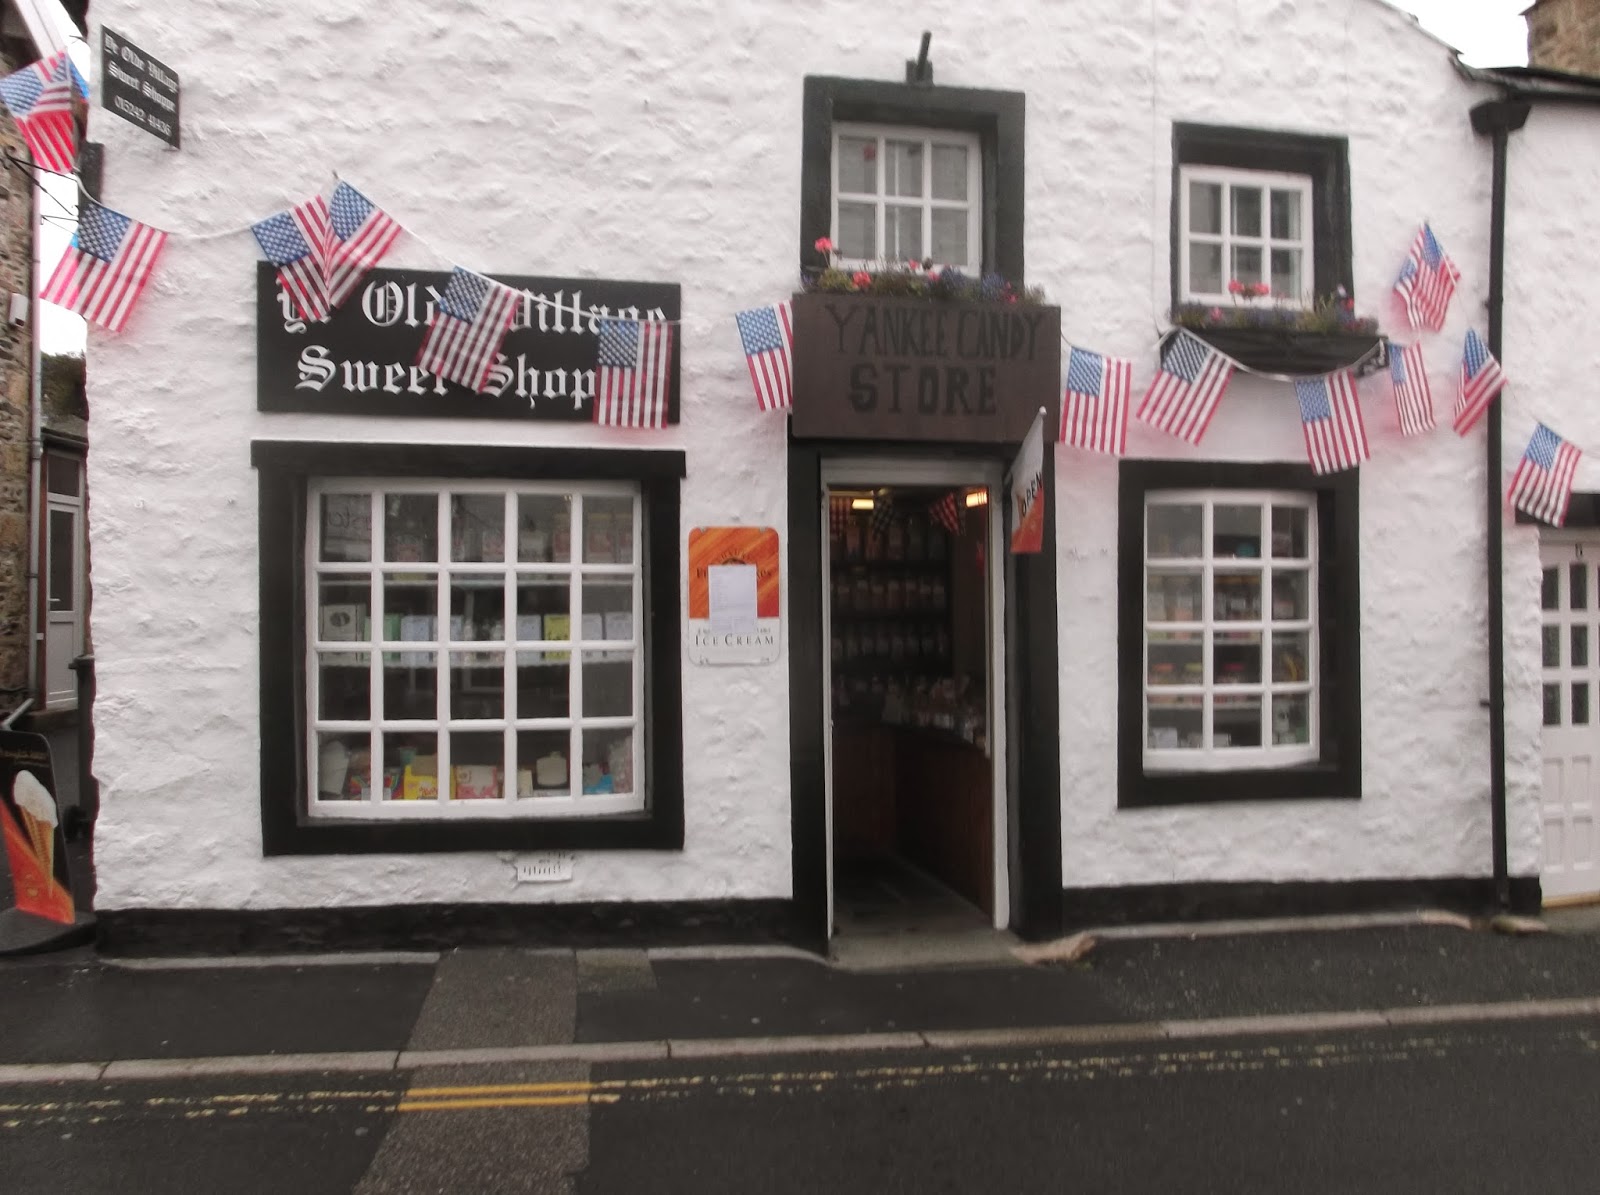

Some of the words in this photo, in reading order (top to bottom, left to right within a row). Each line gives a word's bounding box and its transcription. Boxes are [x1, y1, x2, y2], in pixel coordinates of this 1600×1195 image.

[108, 60, 140, 91] Sweet
[824, 304, 948, 357] YANKEE
[956, 307, 1045, 361] CANDY
[848, 362, 997, 416] STORE
[1021, 471, 1043, 518] OPEN
